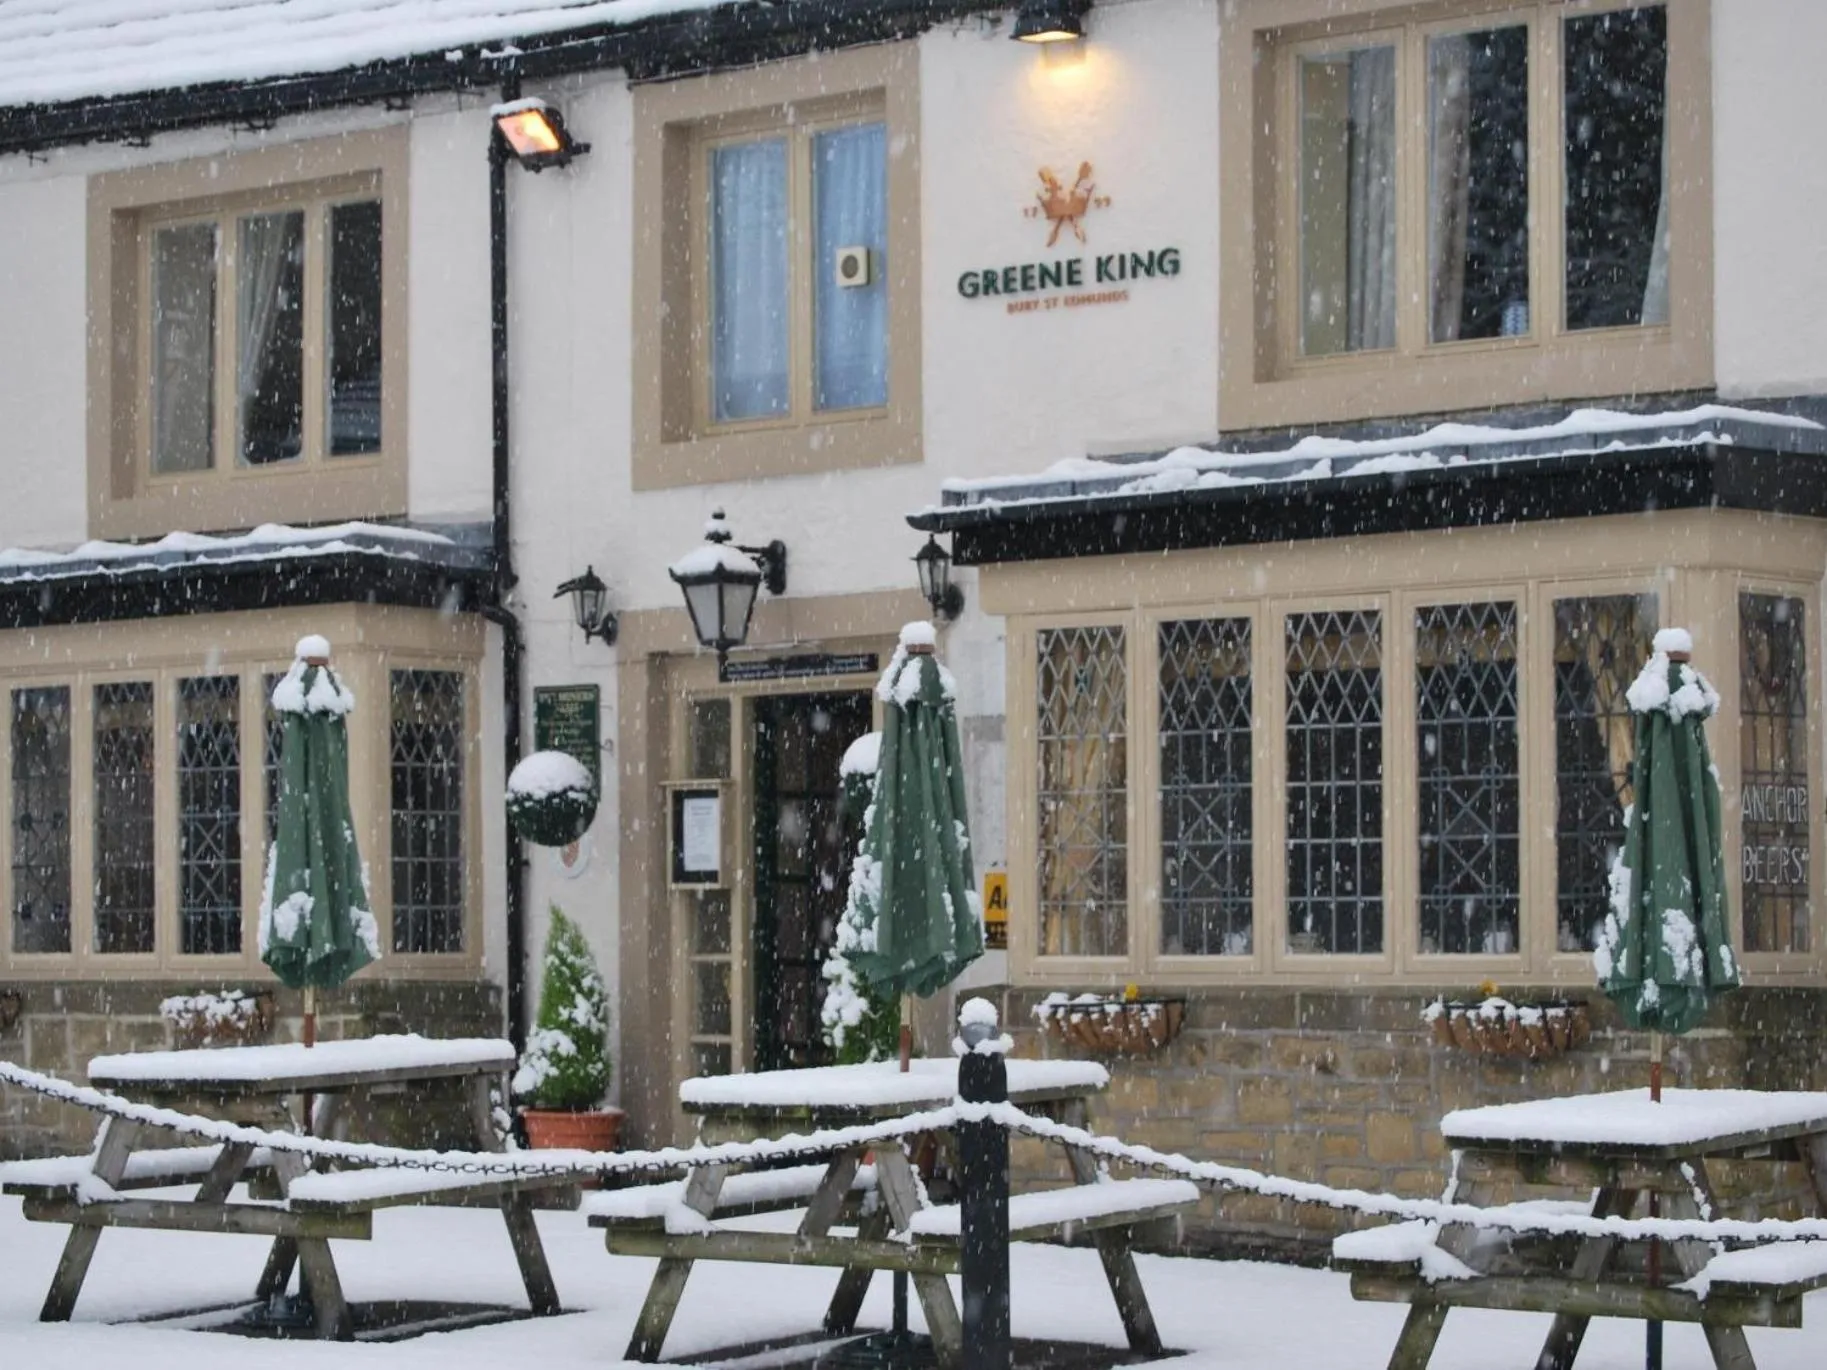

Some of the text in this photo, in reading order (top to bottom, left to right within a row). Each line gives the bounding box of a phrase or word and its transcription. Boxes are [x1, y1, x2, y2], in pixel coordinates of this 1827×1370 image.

[957, 247, 1181, 299] GREENE KING
[1006, 290, 1130, 315] BURY ST EDMUNDS
[1742, 784, 1807, 822] ANCHOR
[987, 884, 1007, 910] A
